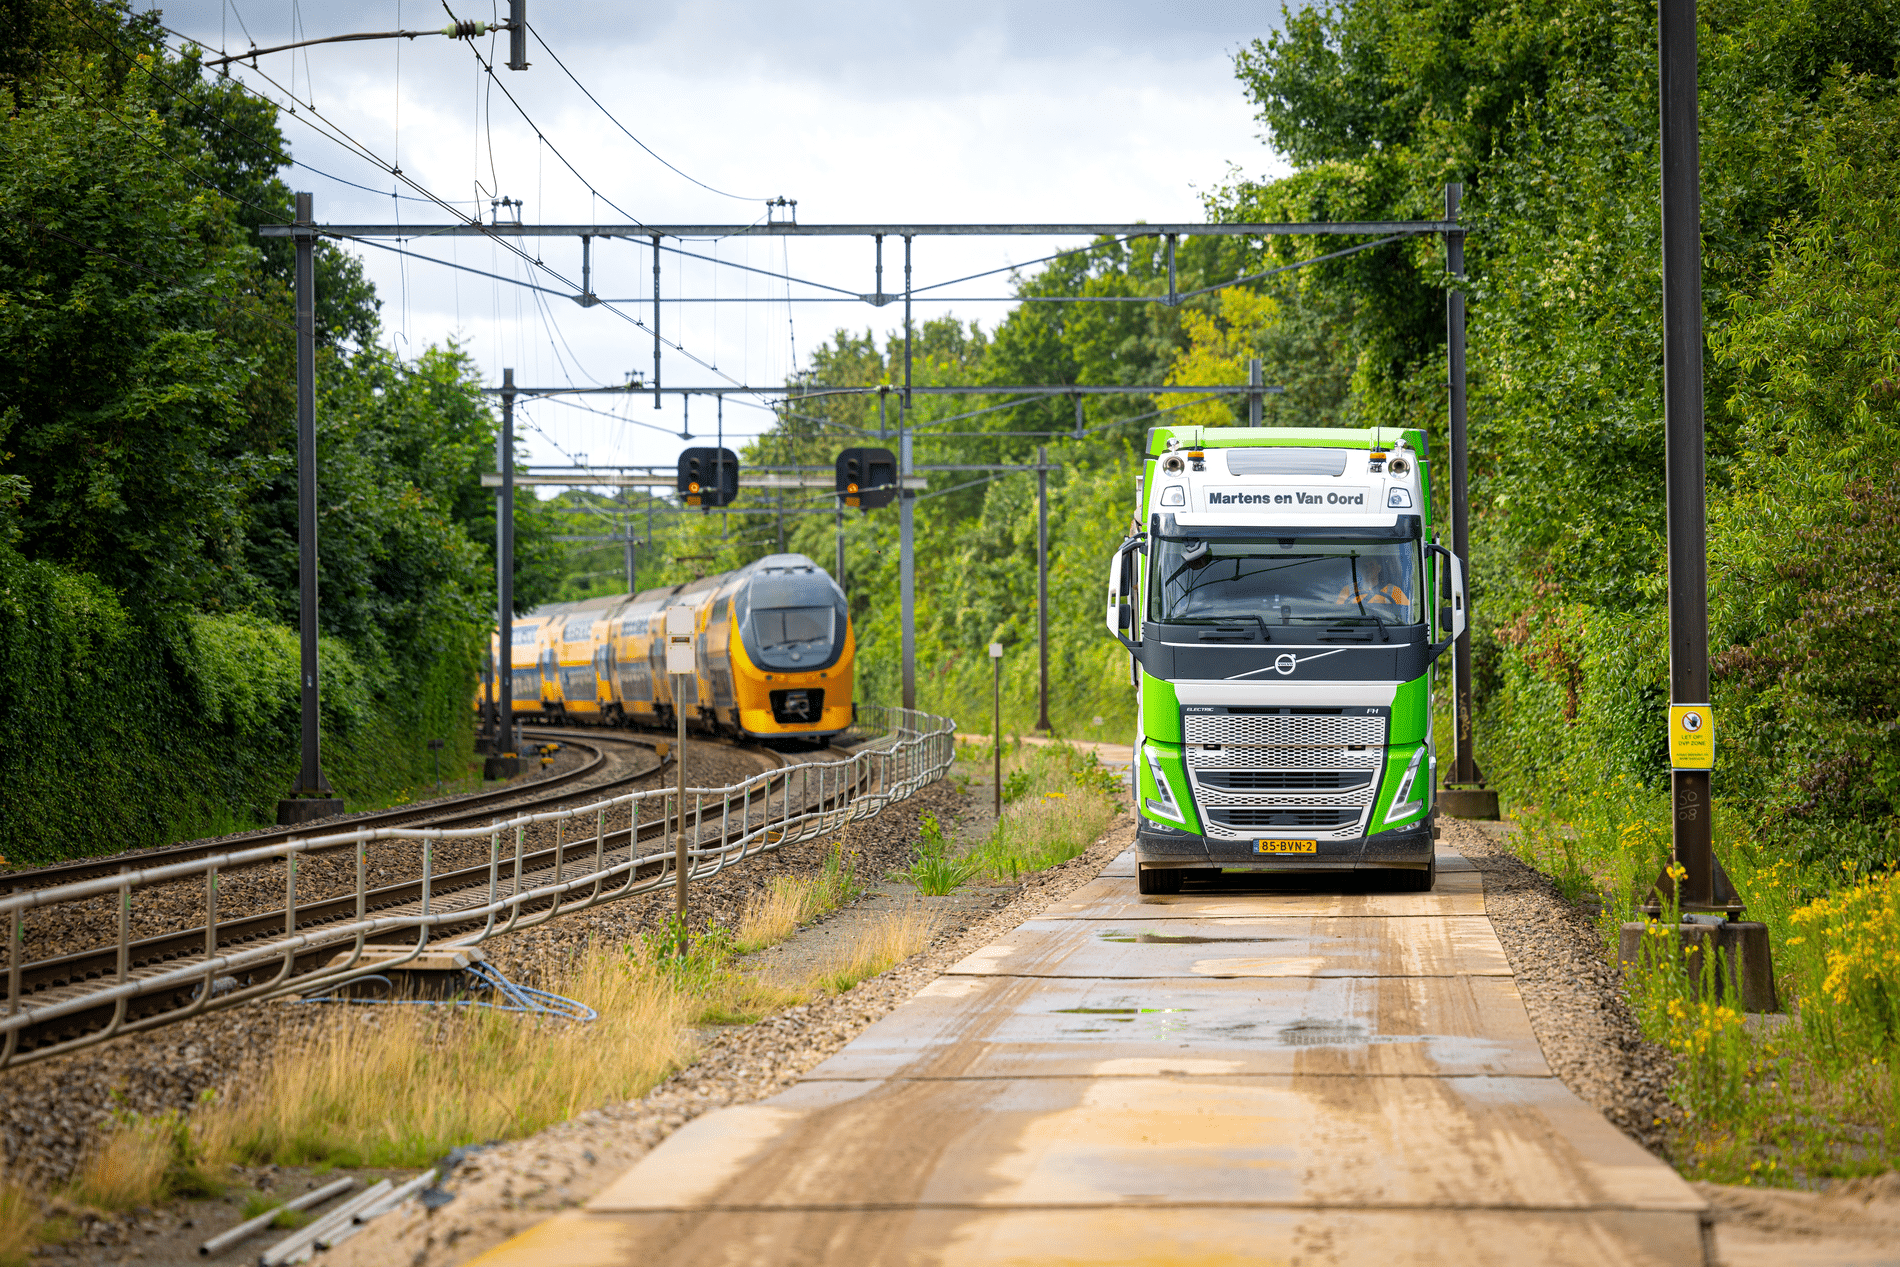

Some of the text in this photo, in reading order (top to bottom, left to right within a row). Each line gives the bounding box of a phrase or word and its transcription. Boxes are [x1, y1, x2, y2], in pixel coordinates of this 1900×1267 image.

[1209, 492, 1364, 505] Martens en Van Oord
[1679, 789, 1698, 806] 50
[1678, 808, 1697, 821] 08
[1262, 841, 1312, 851] 85-BVN-2
